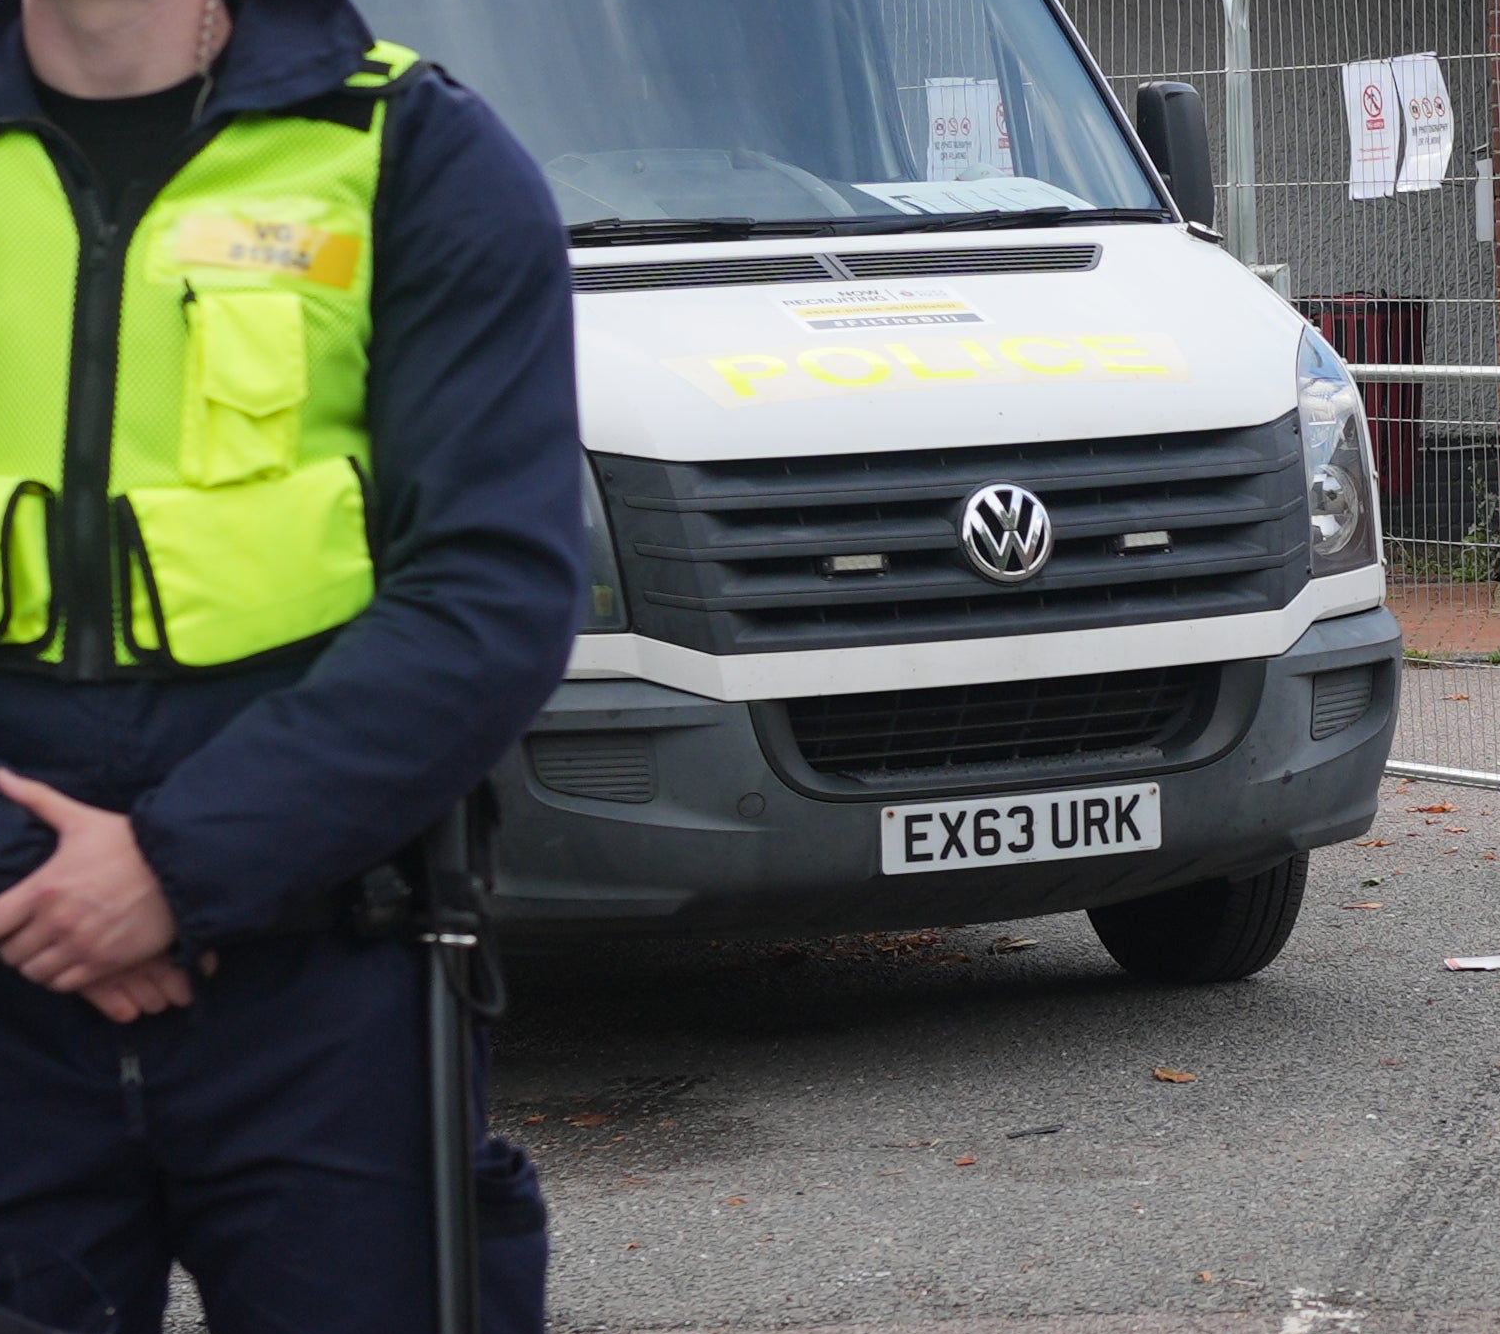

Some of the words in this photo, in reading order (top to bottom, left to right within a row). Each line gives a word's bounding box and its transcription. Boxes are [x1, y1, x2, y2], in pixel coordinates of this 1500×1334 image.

[782, 295, 889, 307] RECRUITING
[833, 315, 959, 327] #FitTheBill
[708, 335, 1170, 397] POLICE
[904, 805, 1034, 863] EX63
[1051, 794, 1142, 849] URK
